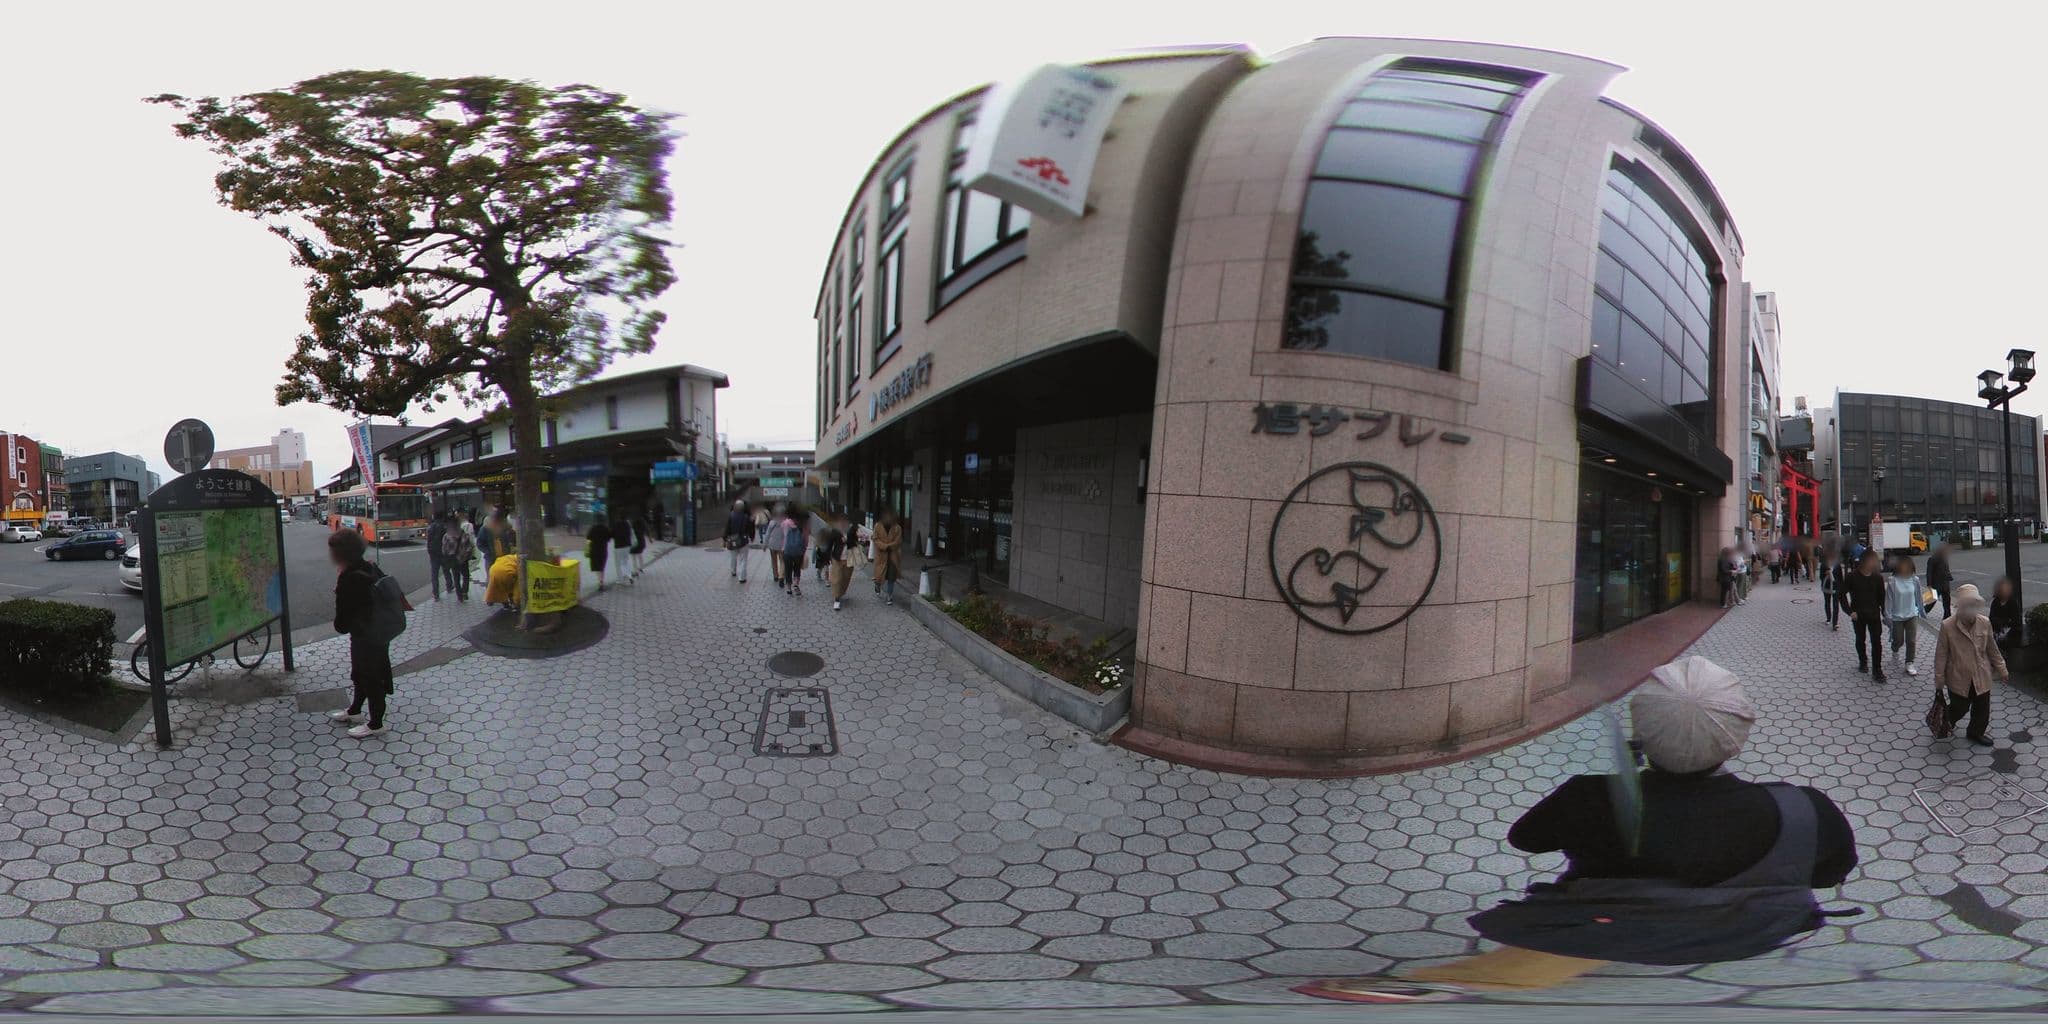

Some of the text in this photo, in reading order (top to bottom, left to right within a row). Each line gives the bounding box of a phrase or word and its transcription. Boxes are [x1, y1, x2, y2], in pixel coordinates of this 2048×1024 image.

[195, 477, 252, 492] ようこそ鎌倉
